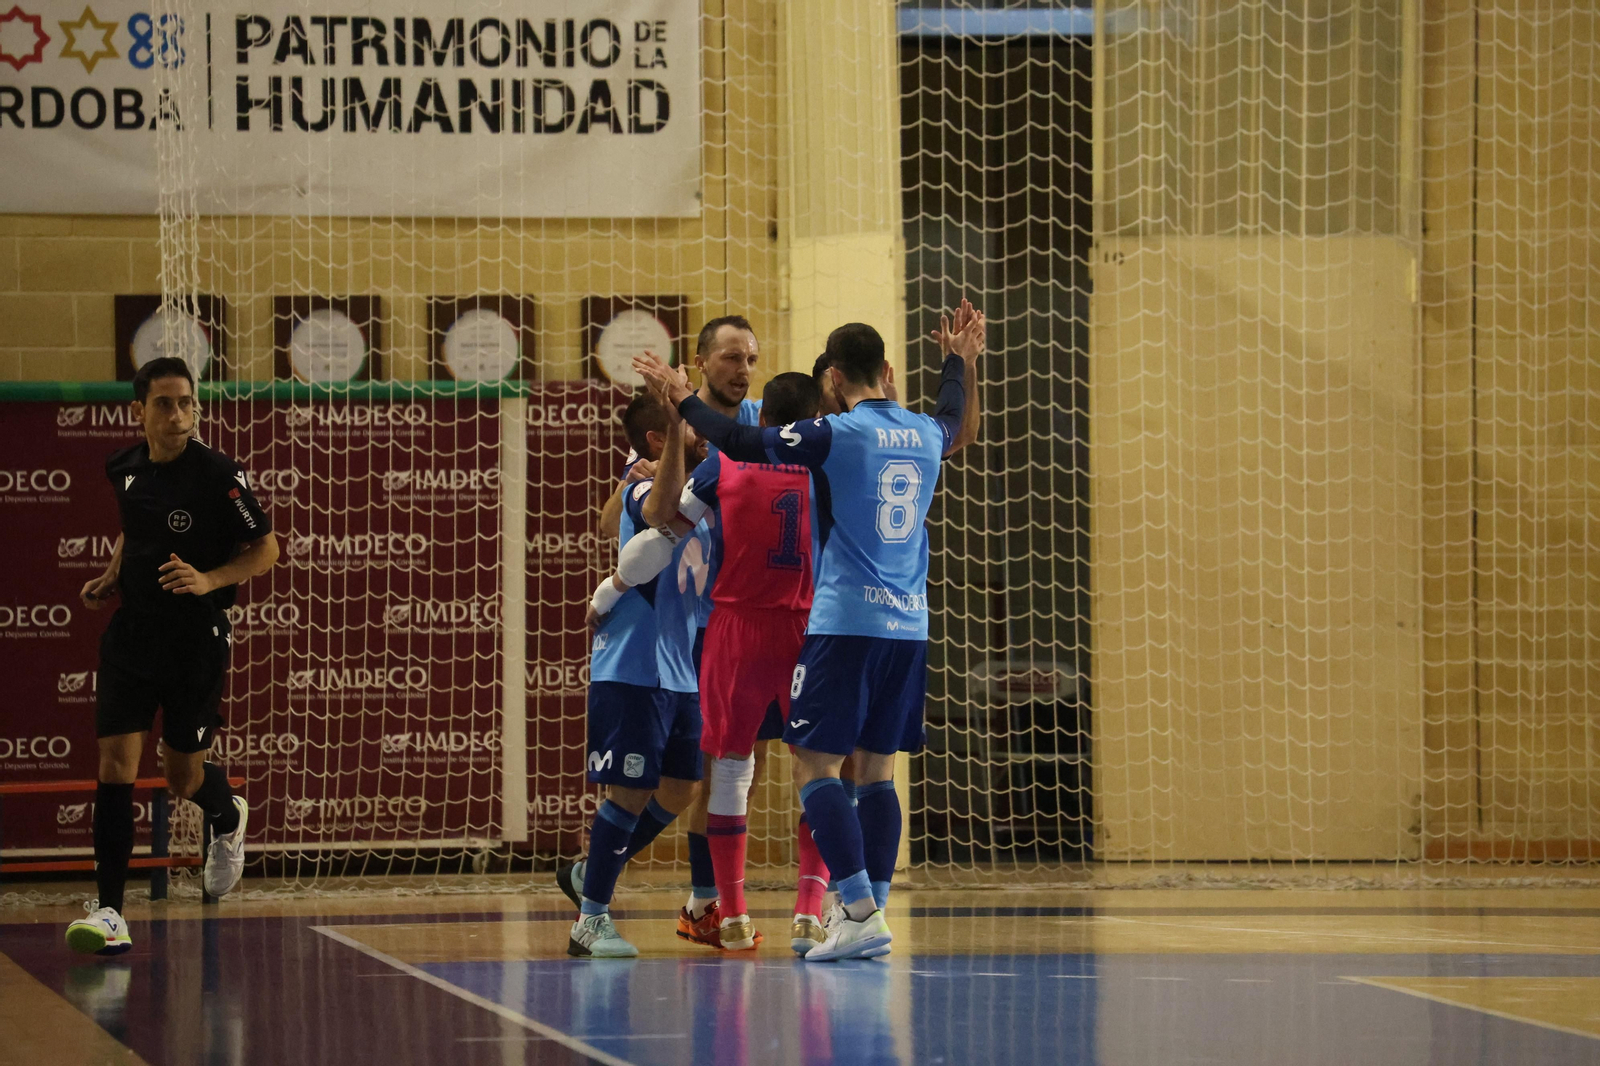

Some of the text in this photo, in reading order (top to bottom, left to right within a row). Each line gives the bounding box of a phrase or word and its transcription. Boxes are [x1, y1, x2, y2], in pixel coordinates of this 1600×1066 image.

[236, 15, 621, 68] PATRIMONIO
[635, 20, 668, 42] DE
[634, 47, 668, 69] LA
[236, 75, 670, 134] HUMANIDAD
[318, 404, 426, 426] IMDECO
[875, 427, 923, 448] RAYA
[875, 460, 922, 543] 8
[234, 498, 256, 529] WÜRTH
[767, 489, 805, 572] 1
[319, 534, 427, 555] IMDECO
[319, 666, 427, 689] IMDECO
[790, 664, 807, 699] 8
[319, 796, 427, 818] IMDECO
